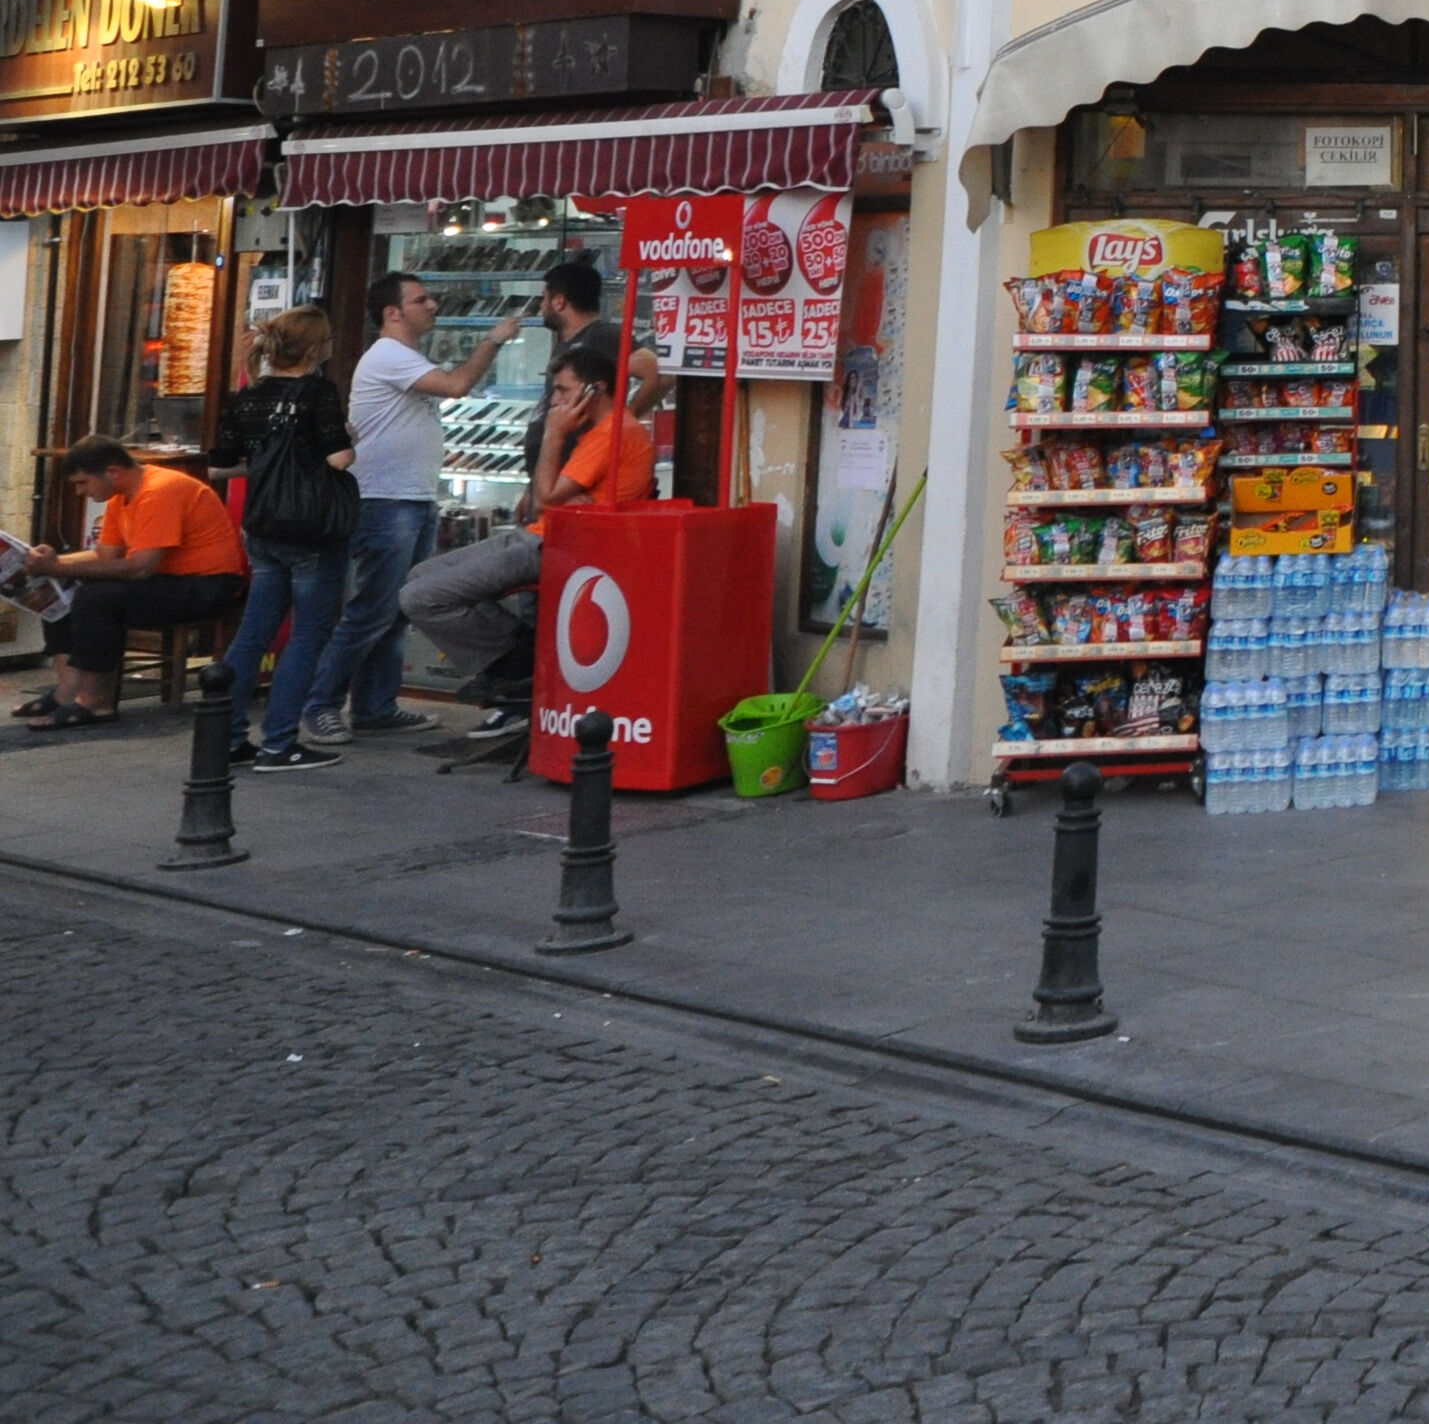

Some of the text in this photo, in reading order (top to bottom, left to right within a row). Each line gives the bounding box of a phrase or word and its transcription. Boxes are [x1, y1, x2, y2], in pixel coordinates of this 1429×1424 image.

[73, 51, 196, 93] Tel: 212 53 60
[347, 39, 485, 104] 2012
[1313, 133, 1385, 147] FOTOKOPİ
[638, 231, 725, 262] vodafone
[1091, 234, 1158, 274] Lay's
[742, 299, 793, 318] SADECE
